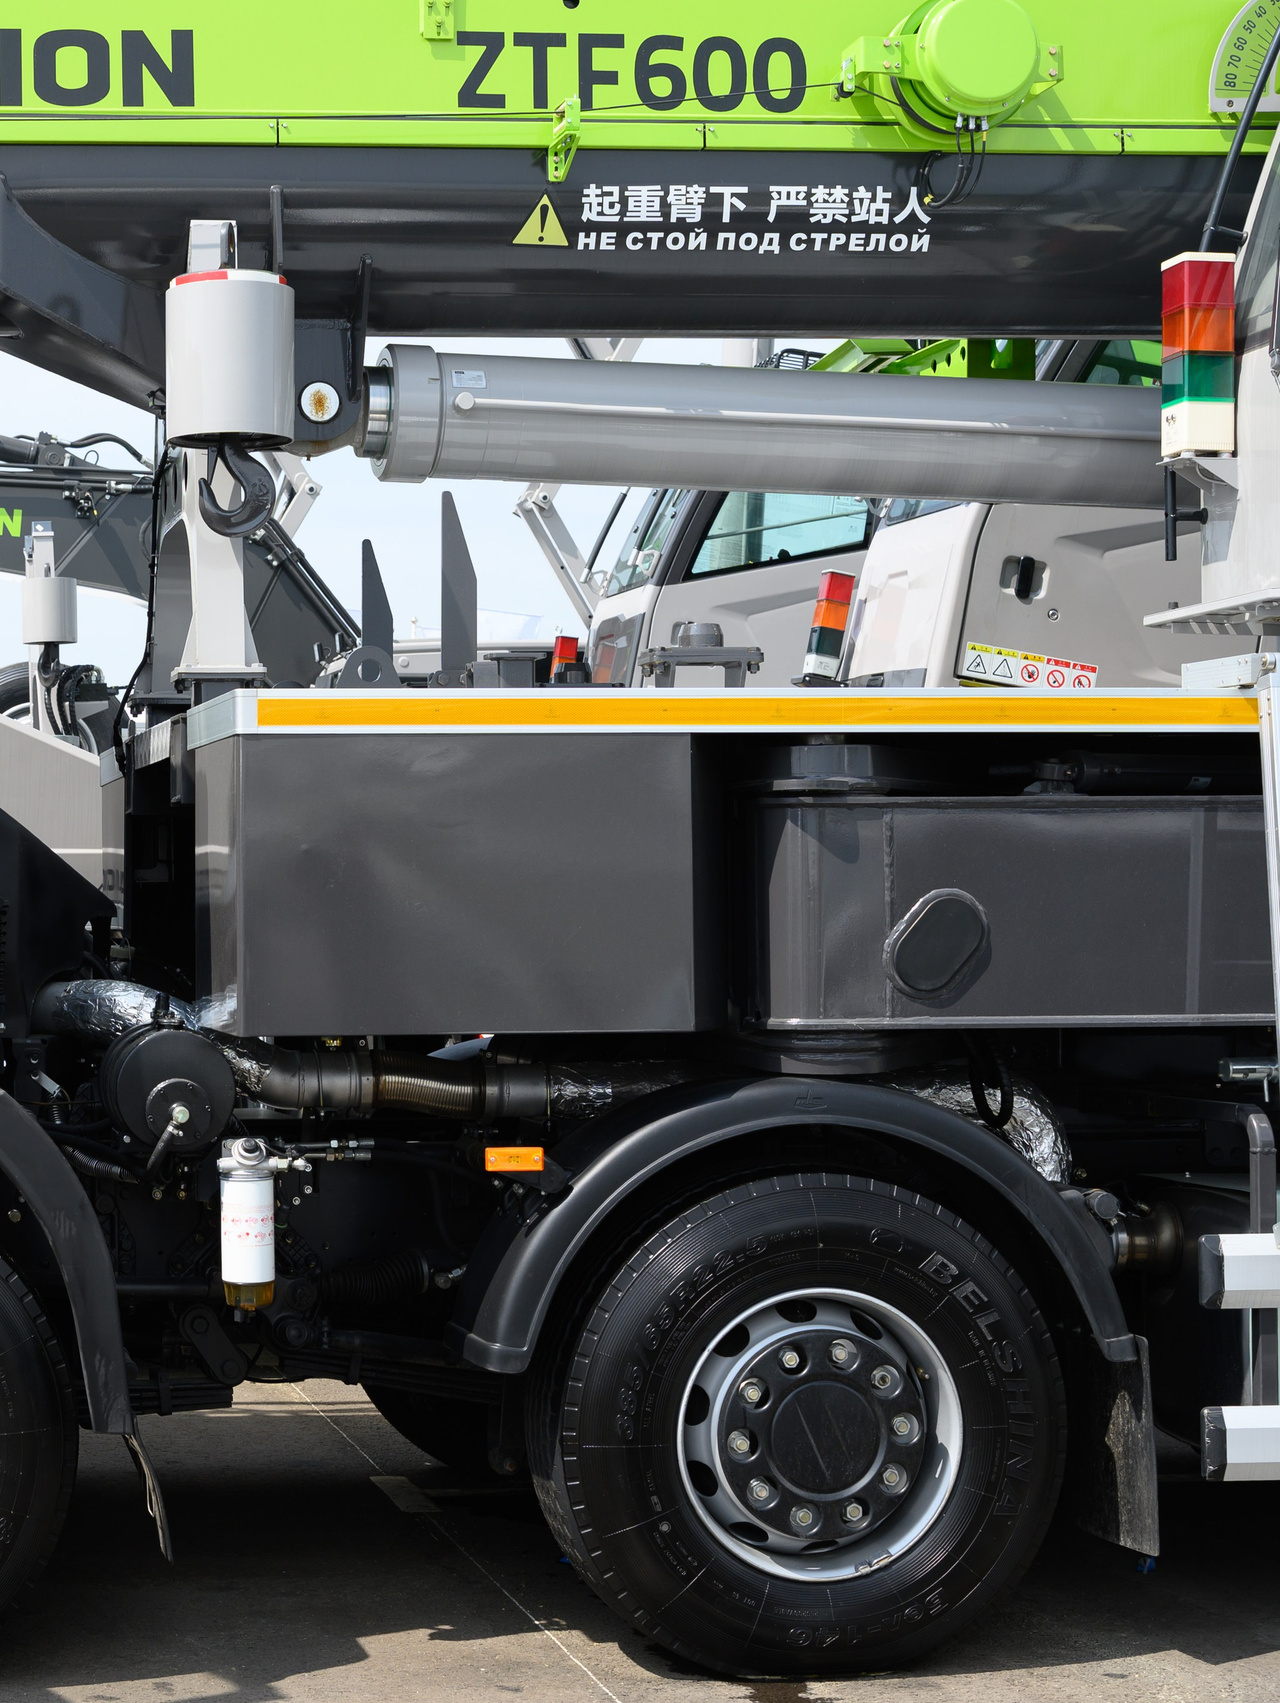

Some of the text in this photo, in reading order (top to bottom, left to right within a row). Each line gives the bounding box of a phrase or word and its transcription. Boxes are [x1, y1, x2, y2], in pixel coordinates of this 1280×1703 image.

[1254, 5, 1267, 19] 40
[1242, 19, 1257, 34] 50
[1233, 36, 1248, 51] 60
[1227, 54, 1242, 69] 70
[456, 31, 808, 113] ZTF600
[1223, 73, 1237, 88] 80
[581, 184, 932, 225] 起重臂下 严禁站人
[577, 228, 931, 254] НЕ СТОЙ ПОД СТРЕЛОЙ
[917, 1250, 1034, 1517] BELSHINA
